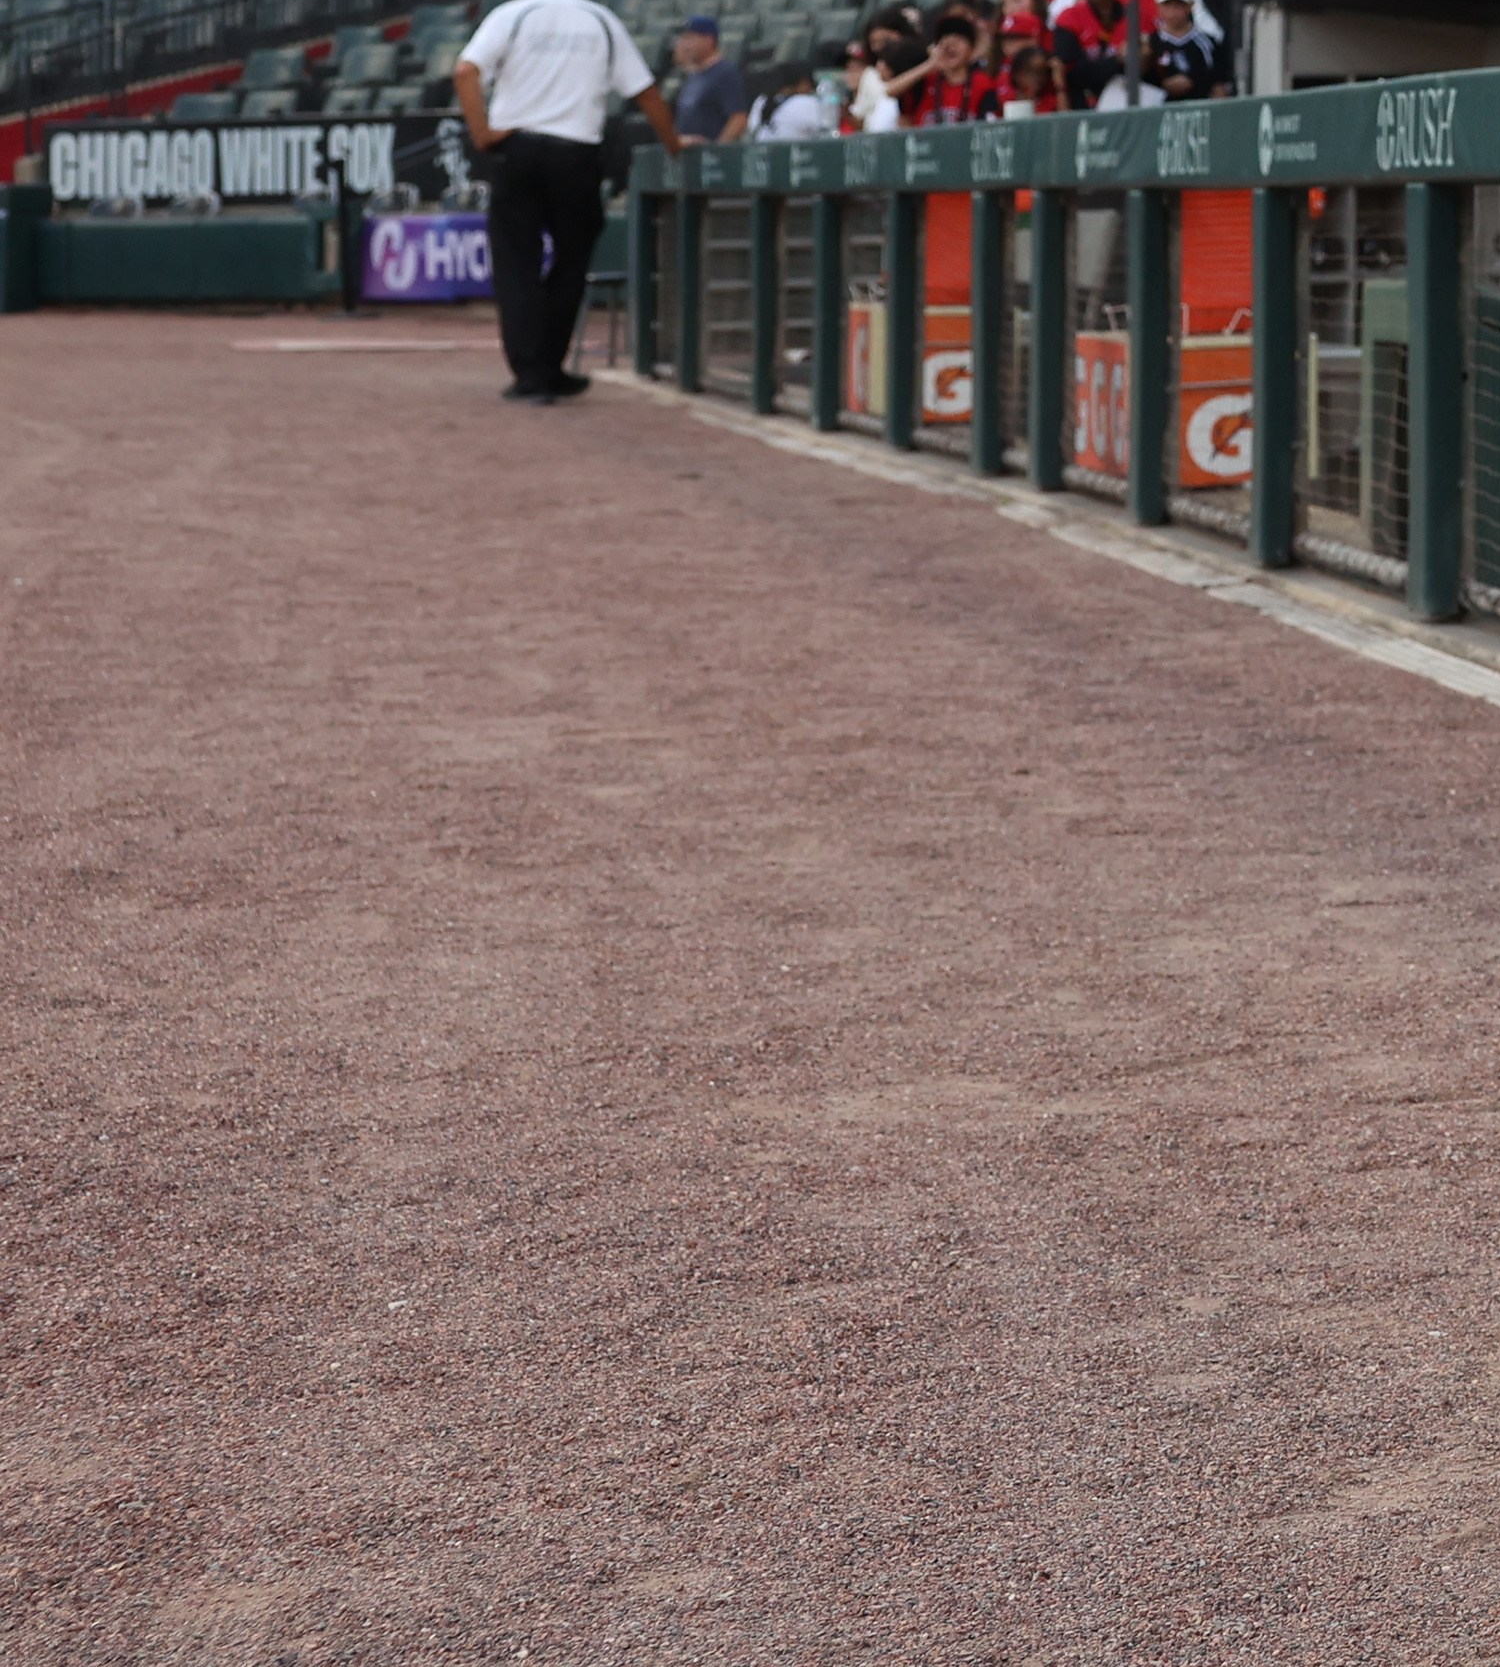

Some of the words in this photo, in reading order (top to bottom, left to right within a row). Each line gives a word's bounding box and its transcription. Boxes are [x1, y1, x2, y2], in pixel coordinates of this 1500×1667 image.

[49, 128, 216, 201] CHICAGO
[219, 126, 324, 196] WHITE
[1396, 88, 1457, 166] RUSH
